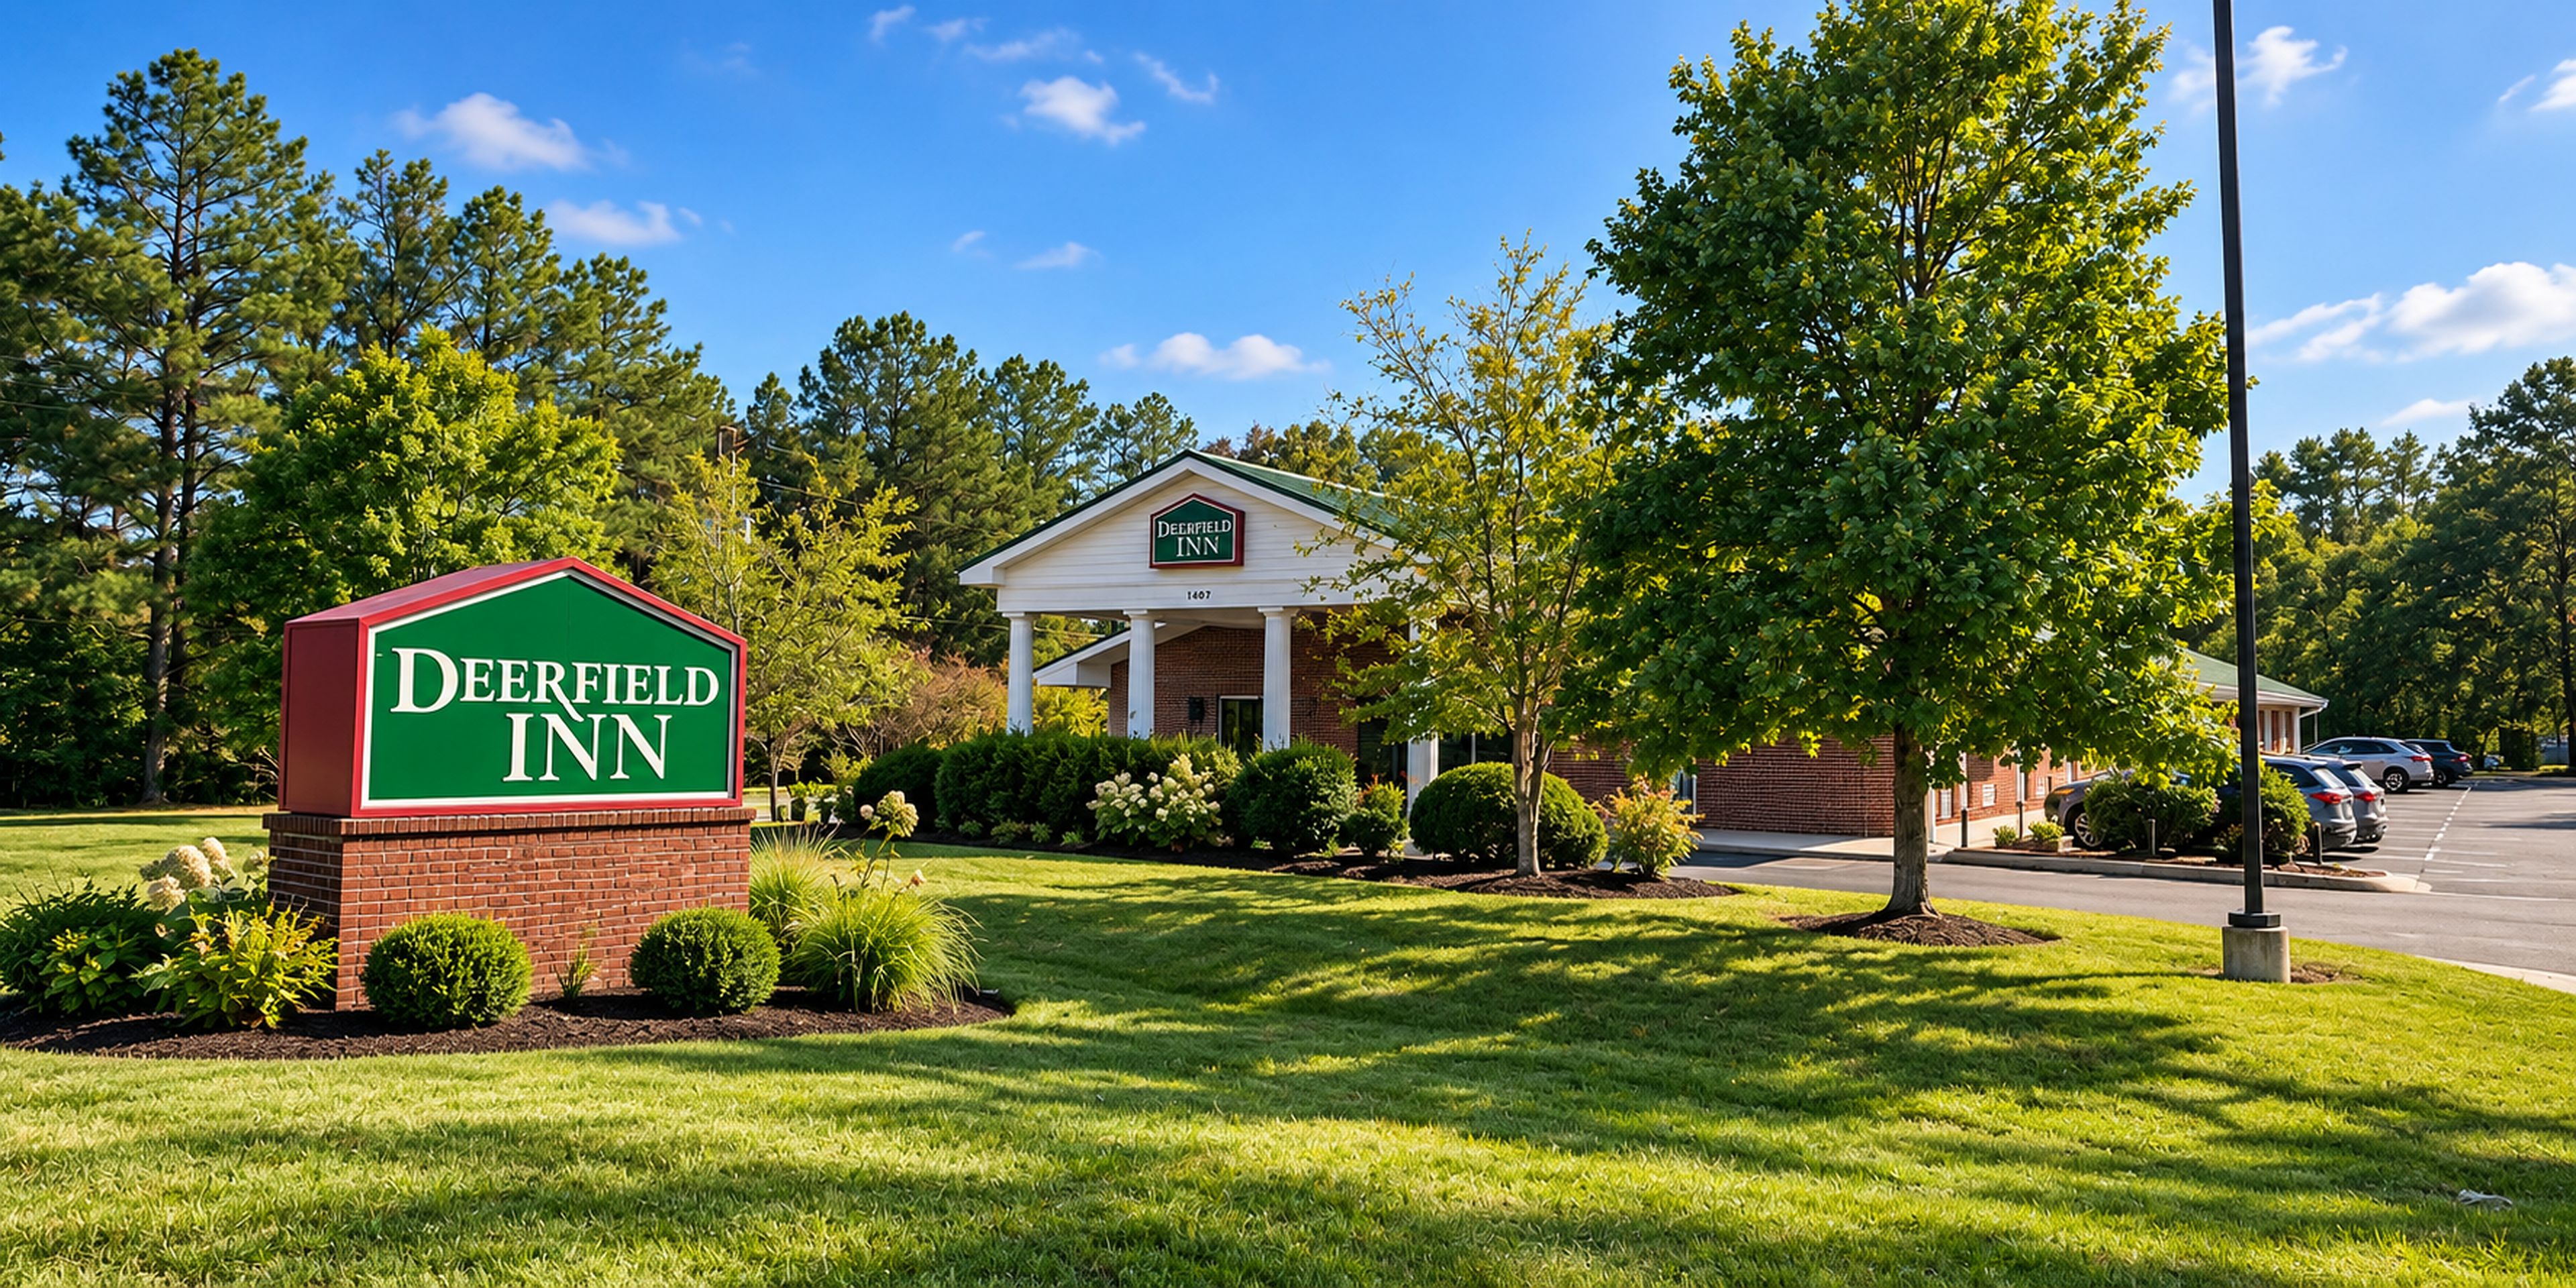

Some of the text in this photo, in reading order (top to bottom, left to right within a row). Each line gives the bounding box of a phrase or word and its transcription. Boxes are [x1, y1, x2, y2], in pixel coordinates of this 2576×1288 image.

[1157, 520, 1232, 538] DEERFIELD
[1176, 536, 1219, 557] INN
[1187, 590, 1212, 600] 1407
[390, 647, 719, 722] DEERFIELD
[502, 712, 672, 782] INN
